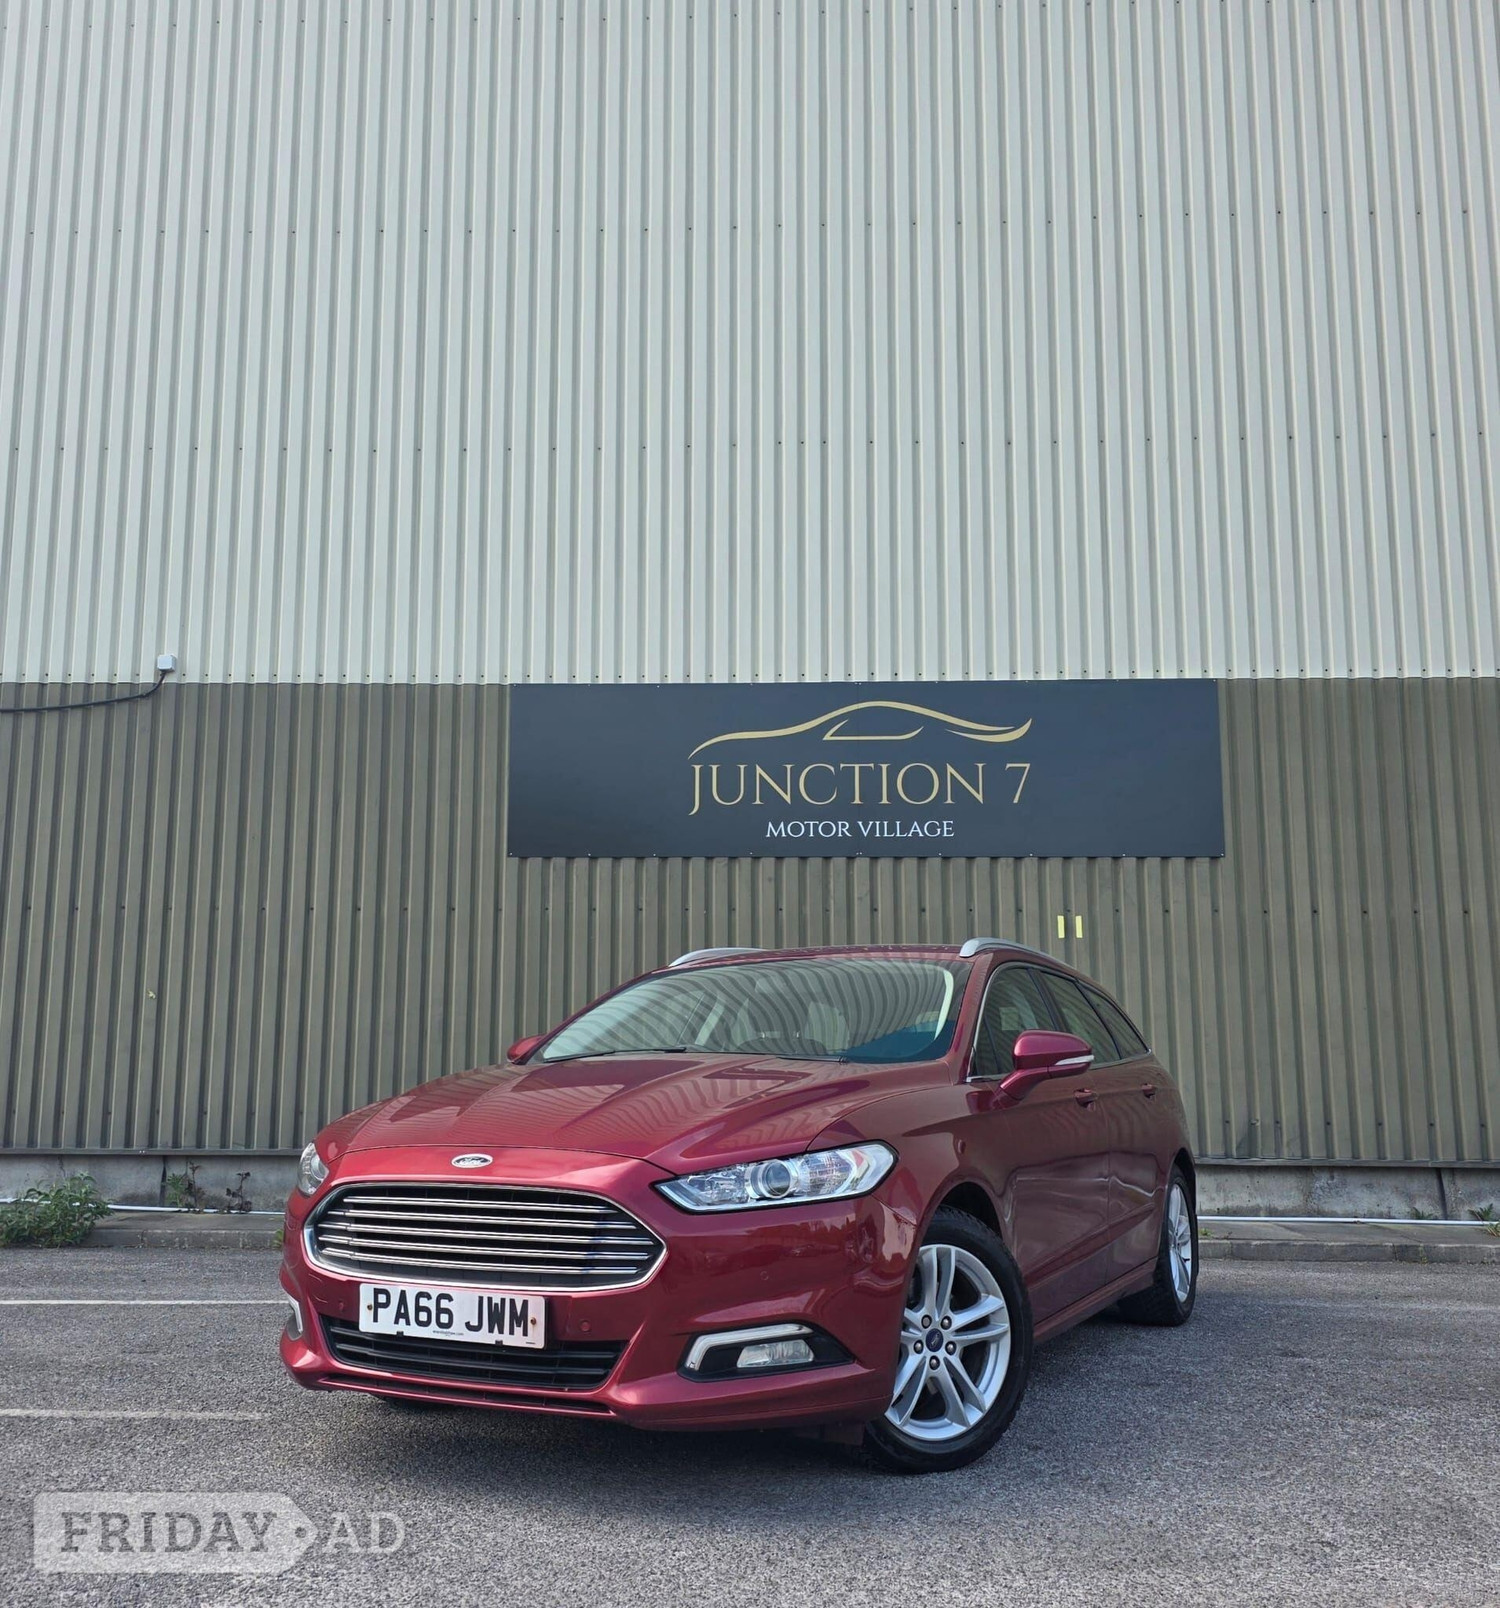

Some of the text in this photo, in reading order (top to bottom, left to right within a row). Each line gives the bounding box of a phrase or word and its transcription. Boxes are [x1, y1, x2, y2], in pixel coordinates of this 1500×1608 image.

[689, 763, 1031, 815] JUNCTION 7
[766, 821, 955, 837] MOTOR VILLAGE
[372, 1287, 529, 1337] PA66 JWM
